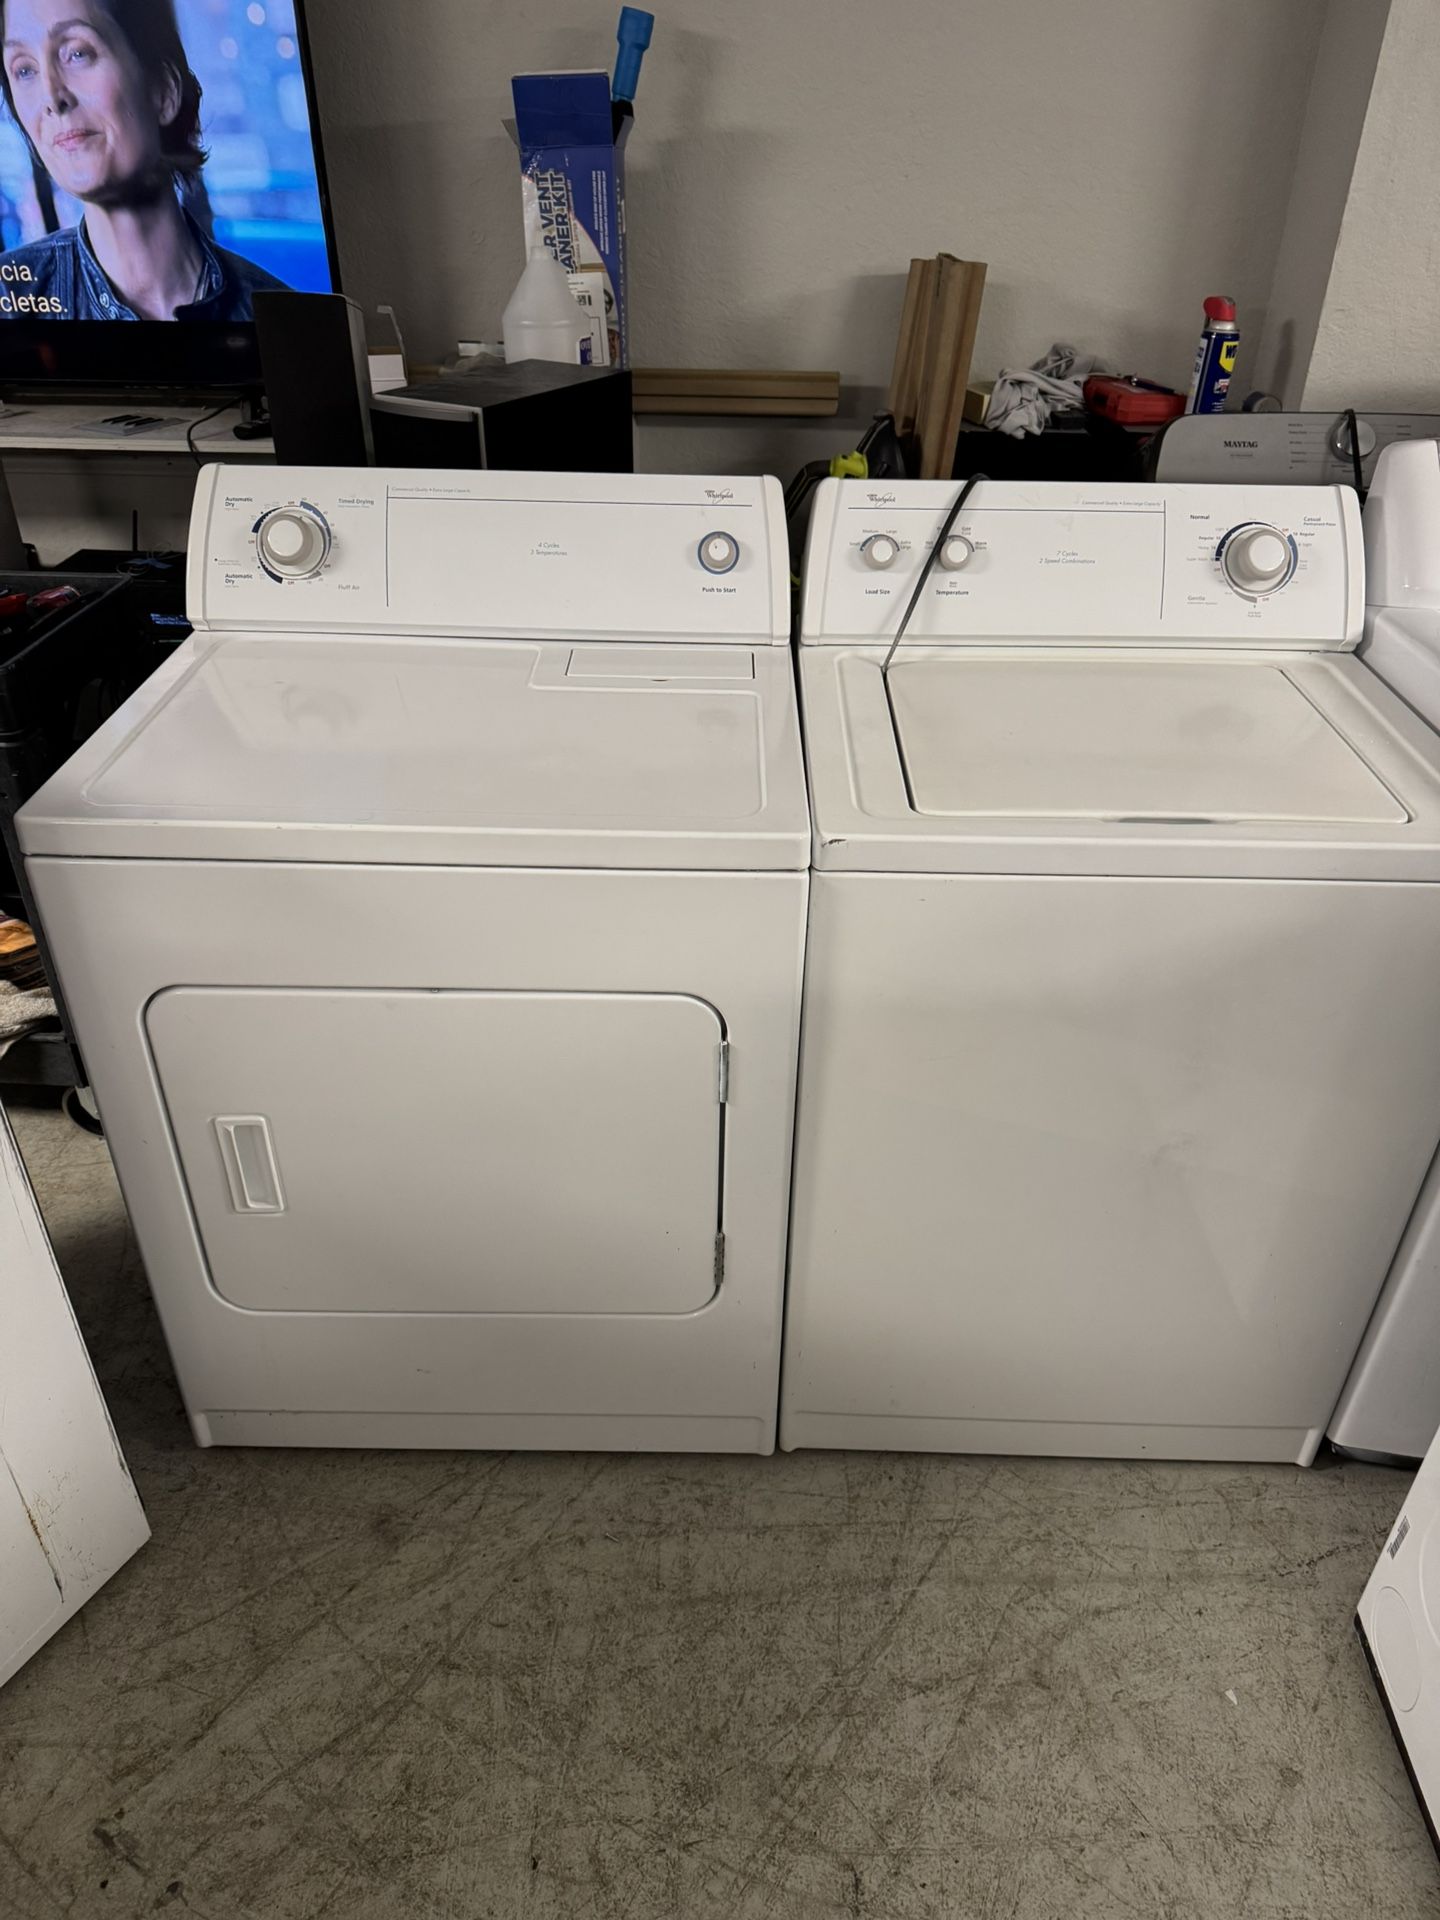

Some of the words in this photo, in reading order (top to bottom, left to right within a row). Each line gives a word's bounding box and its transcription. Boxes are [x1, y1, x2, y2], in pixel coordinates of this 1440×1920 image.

[549, 173, 568, 210] KIT
[534, 172, 556, 229] VENT
[555, 213, 577, 275] ANER
[0, 260, 38, 281] cia.
[0, 290, 68, 312] cletas.
[1223, 440, 1258, 448] MAYTAG
[705, 490, 734, 502] Whirlpool
[868, 494, 896, 504] Whirlpool
[1061, 550, 1078, 558] Cycles
[936, 589, 969, 597] Temperature
